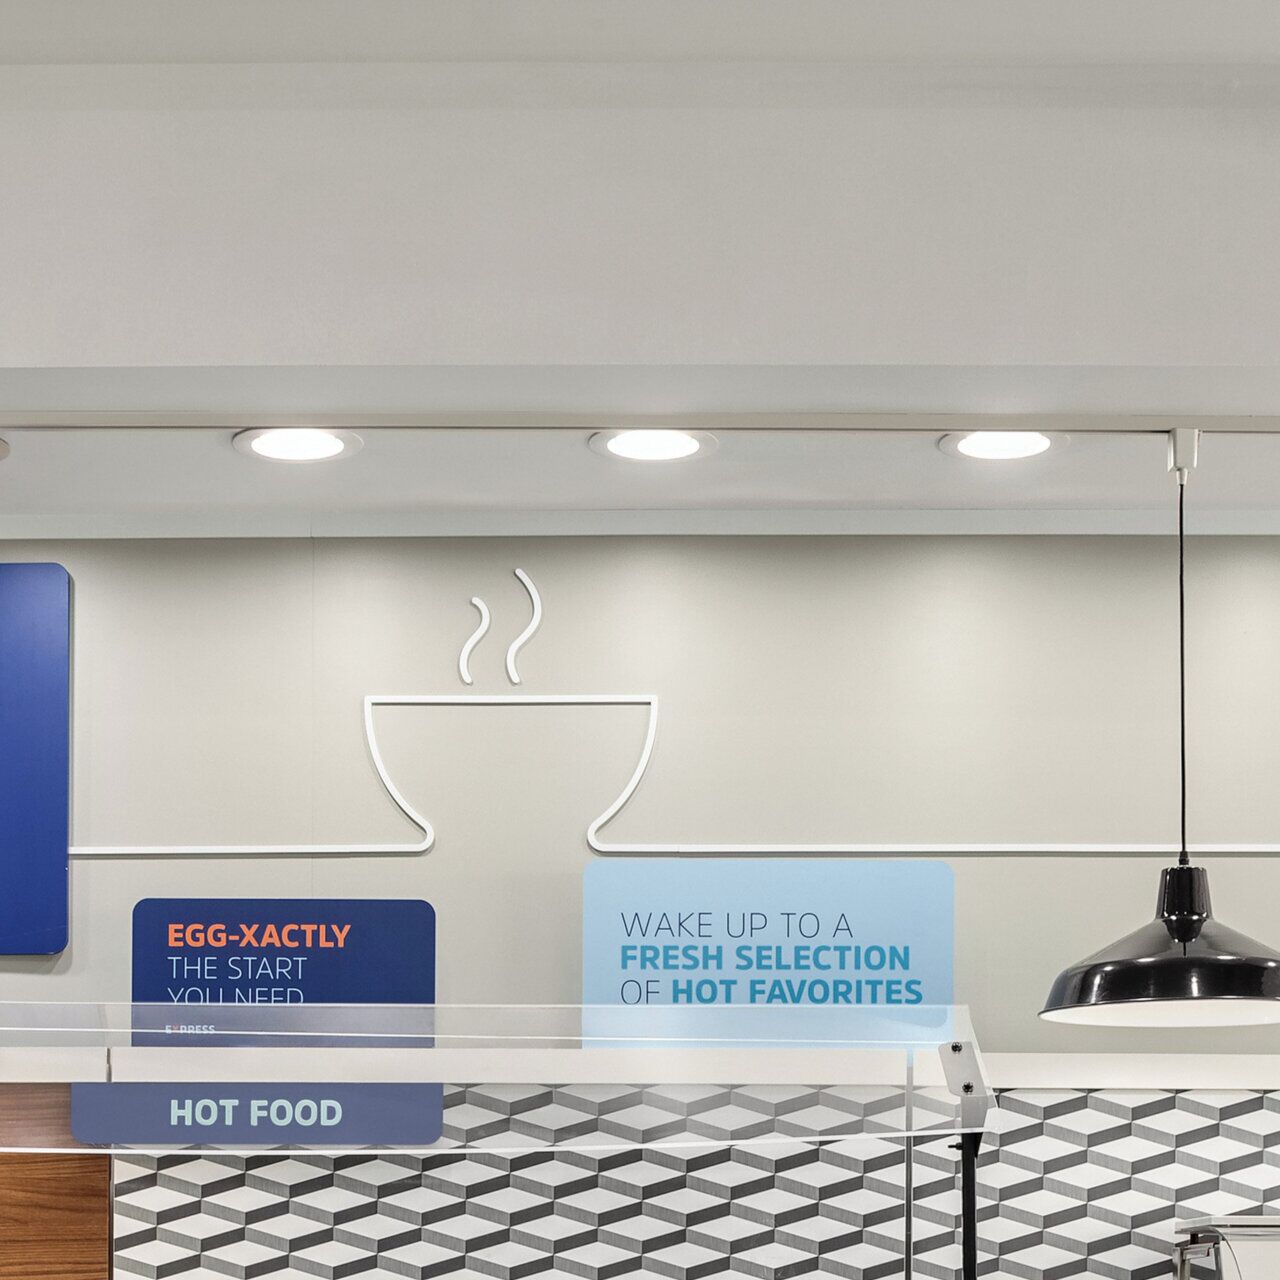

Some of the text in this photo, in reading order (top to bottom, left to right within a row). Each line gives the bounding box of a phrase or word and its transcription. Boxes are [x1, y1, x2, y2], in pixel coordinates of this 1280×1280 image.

[167, 924, 351, 948] EGG-XACTLY
[621, 912, 853, 938] WAKE UP TO A
[167, 956, 307, 980] THE START
[621, 945, 910, 971] FRESH SELECTION
[168, 987, 304, 1003] YOU NEED
[620, 979, 923, 1005] OF HOT FAVORITES
[170, 1099, 343, 1126] HOT FOOD
